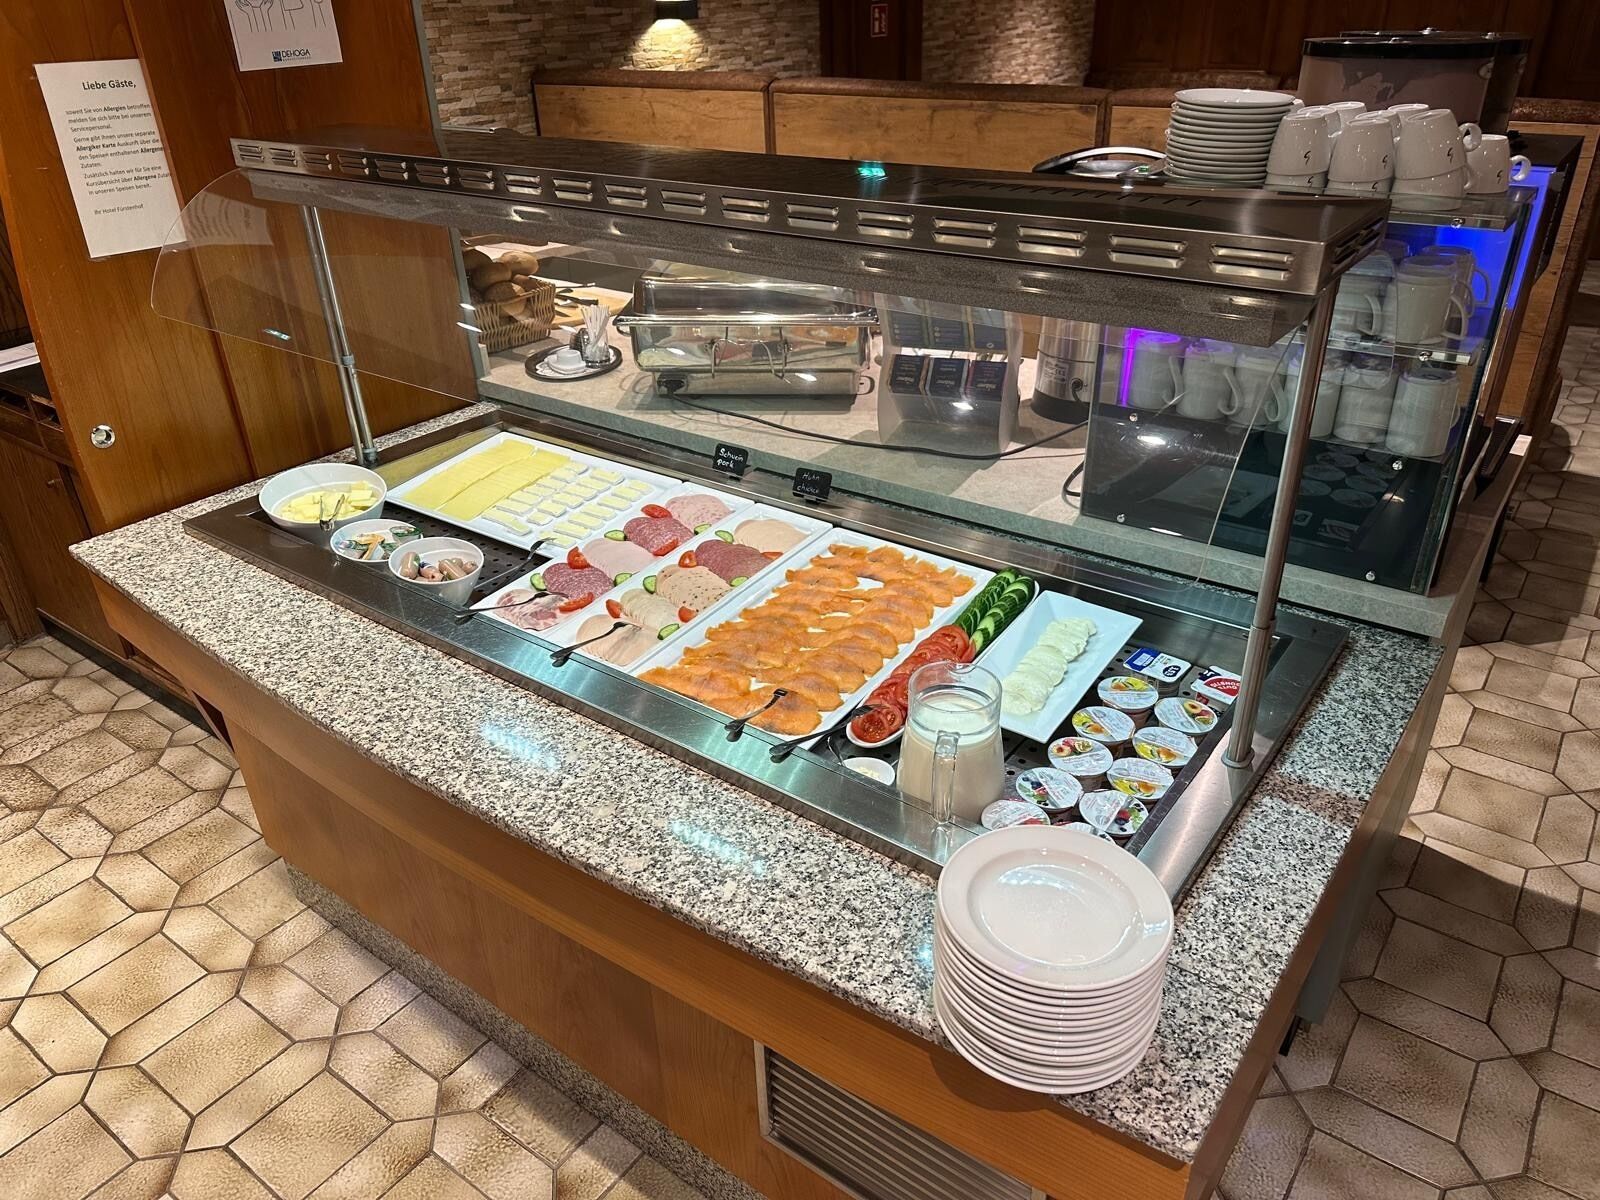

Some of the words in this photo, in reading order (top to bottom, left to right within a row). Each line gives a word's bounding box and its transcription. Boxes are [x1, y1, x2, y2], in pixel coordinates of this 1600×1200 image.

[281, 49, 311, 57] DEHOGA
[82, 80, 107, 91] Liebe
[108, 79, 137, 89] Gäste,
[103, 104, 126, 112] Allergien
[127, 102, 150, 110] betroffen
[97, 114, 107, 122] sich
[91, 134, 101, 142] gibt
[117, 131, 134, 139] unsere
[76, 144, 101, 152] Allergiker
[102, 206, 117, 214] Hotel
[716, 458, 735, 469] pork
